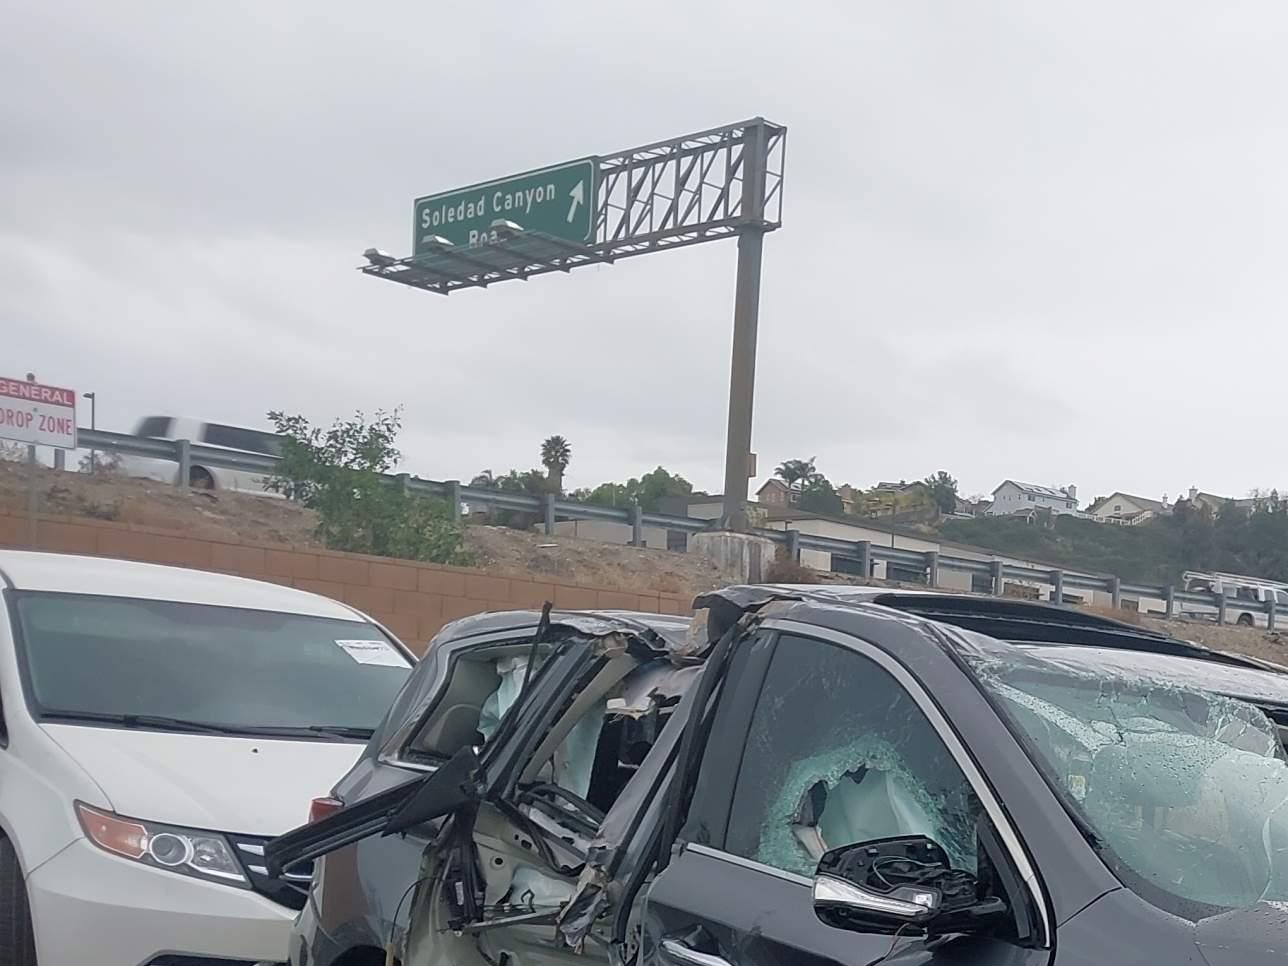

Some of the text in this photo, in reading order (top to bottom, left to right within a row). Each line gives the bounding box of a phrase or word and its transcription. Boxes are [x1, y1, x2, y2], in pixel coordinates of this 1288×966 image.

[421, 183, 556, 229] Soledad Canyon
[468, 229, 507, 248] Roa
[0, 380, 73, 405] GENERAL
[39, 414, 73, 436] ZONE
